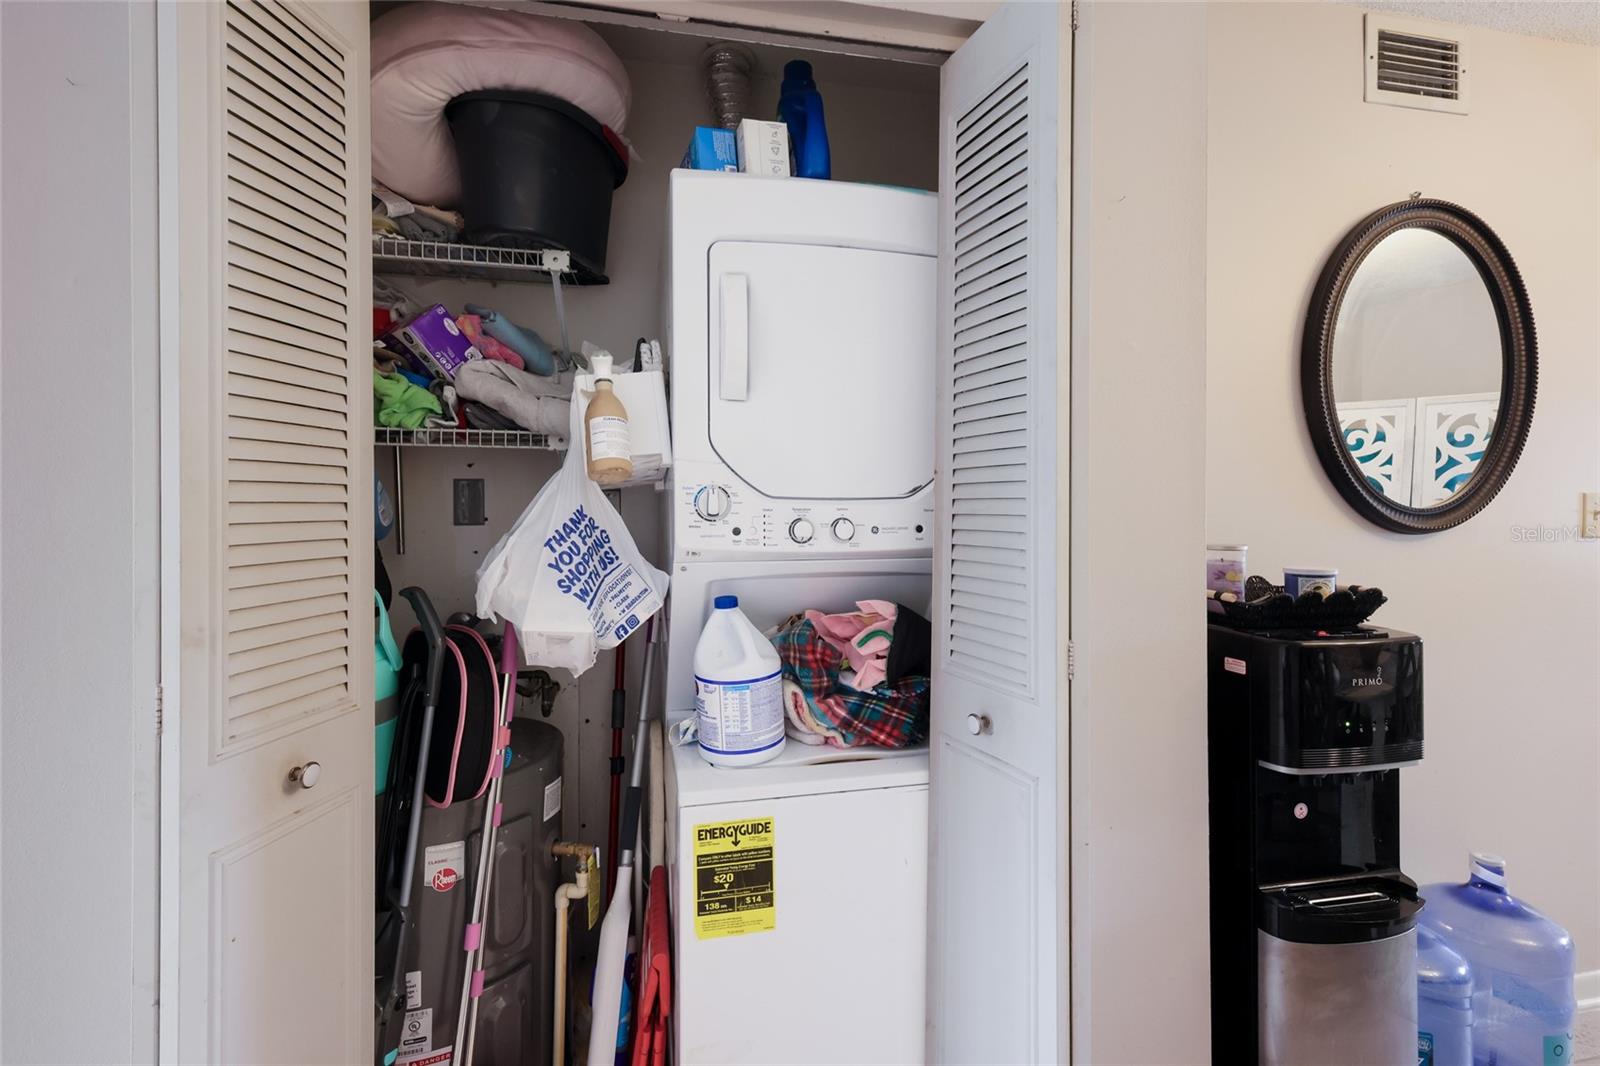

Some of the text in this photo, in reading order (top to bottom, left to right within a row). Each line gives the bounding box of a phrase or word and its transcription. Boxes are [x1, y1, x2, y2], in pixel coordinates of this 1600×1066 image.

[544, 504, 588, 554] THANK
[547, 517, 600, 574] YOU FOR
[556, 529, 612, 595] SHOPPING
[573, 546, 620, 604] WITH US!
[1352, 677, 1383, 687] PRIMO
[697, 822, 771, 840] ENERGYGUIDE
[713, 873, 734, 884] $20
[704, 902, 720, 911] 138
[745, 895, 762, 904] $14
